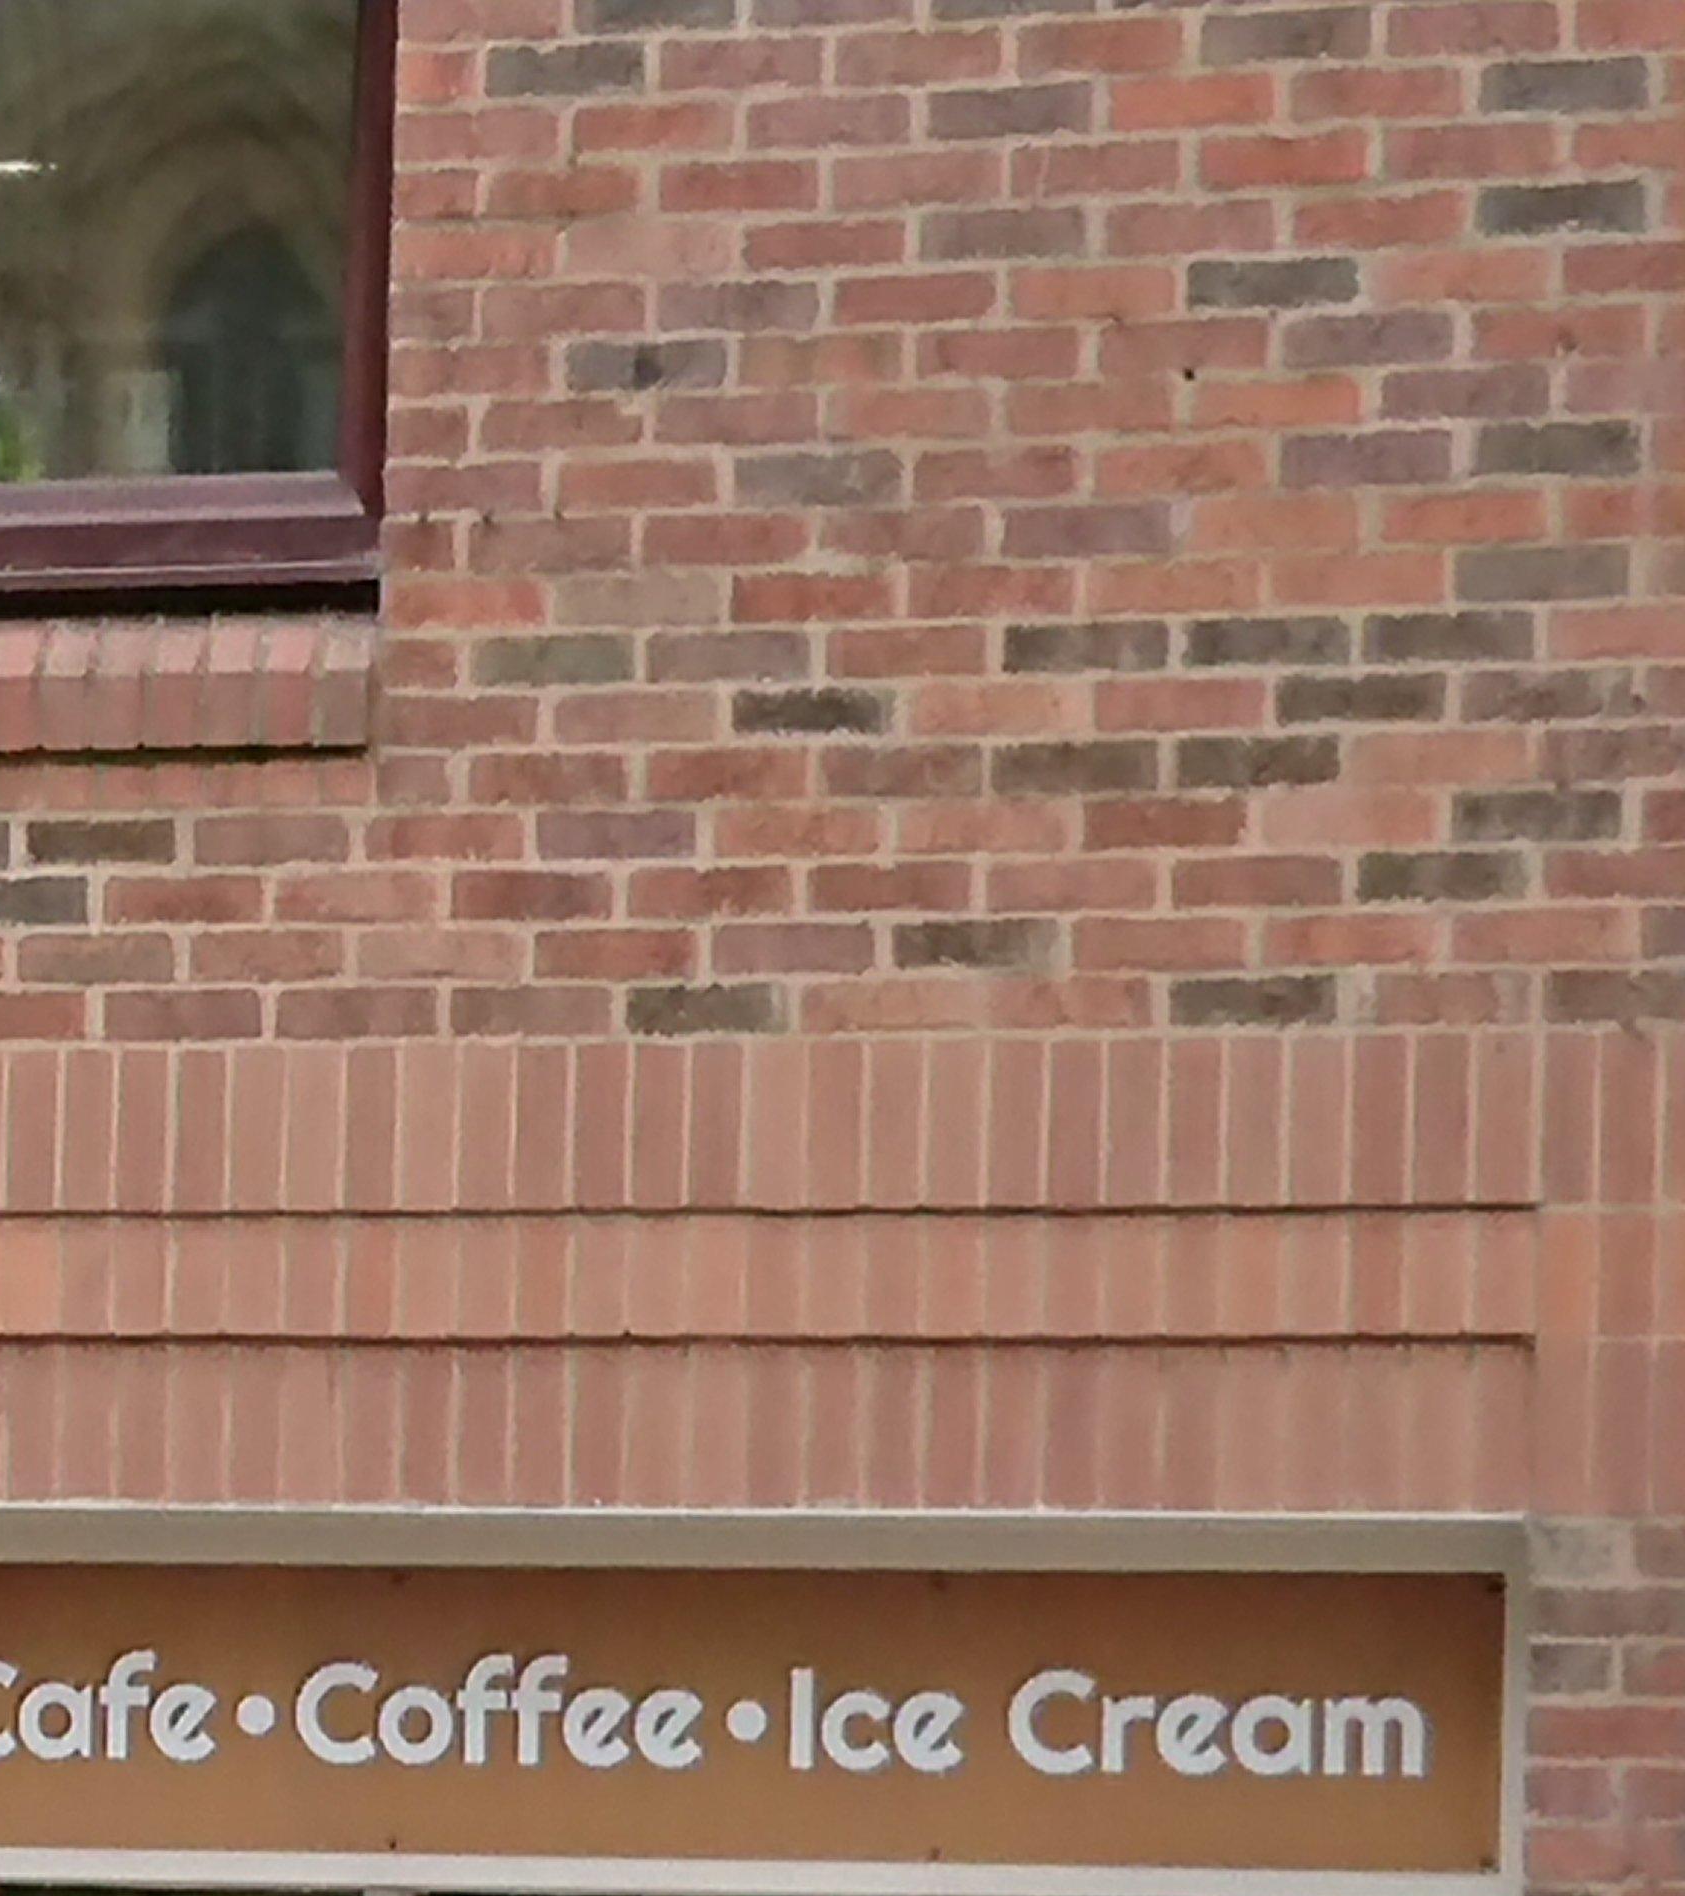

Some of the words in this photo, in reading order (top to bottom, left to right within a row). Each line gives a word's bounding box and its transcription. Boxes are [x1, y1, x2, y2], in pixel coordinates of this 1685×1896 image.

[295, 1654, 703, 1769] Coffee
[789, 1667, 964, 1773] Ice
[1007, 1670, 1424, 1778] Cream
